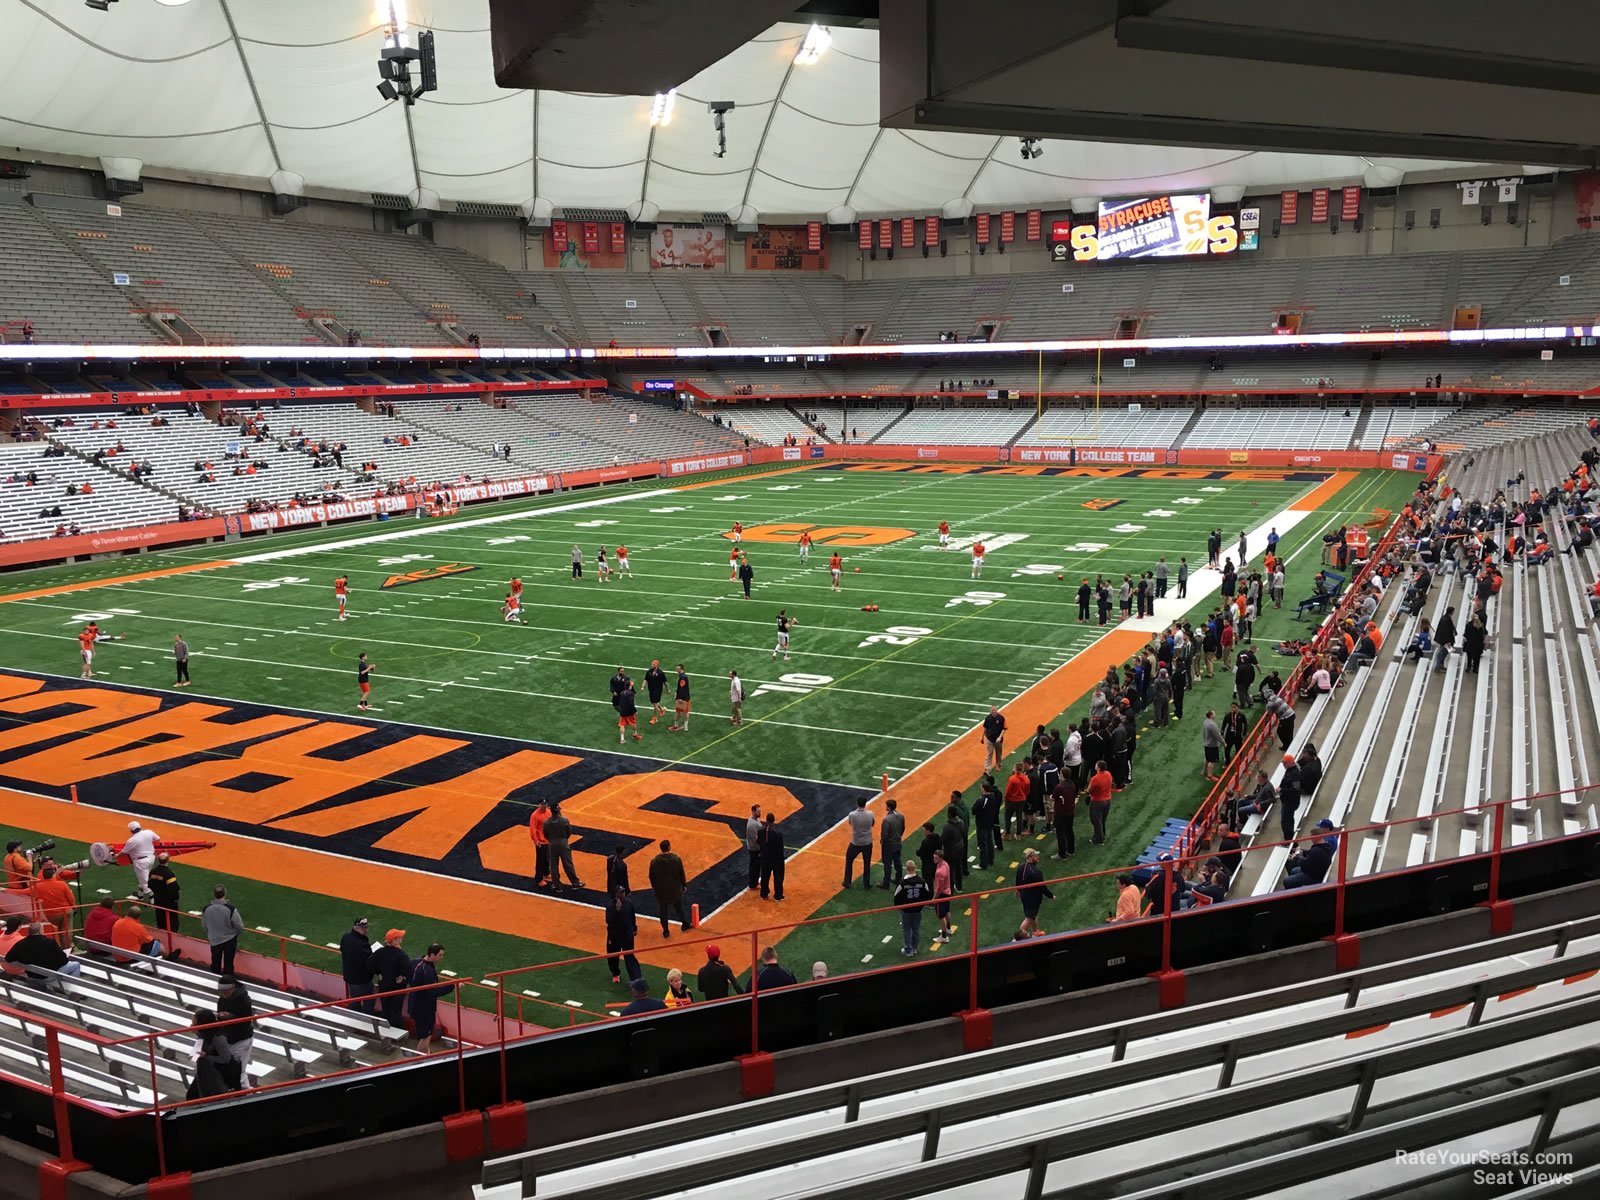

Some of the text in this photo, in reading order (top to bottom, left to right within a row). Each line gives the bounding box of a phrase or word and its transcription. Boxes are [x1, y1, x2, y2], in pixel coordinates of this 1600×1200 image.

[1099, 197, 1170, 231] SYRACUSE
[1071, 225, 1098, 261] S
[1208, 215, 1238, 254] S
[596, 348, 637, 357] SYRACUSE
[111, 393, 119, 404] S
[289, 388, 296, 397] S
[999, 448, 1010, 461] S
[1021, 450, 1155, 463] NEW YORKS COLLEGE TEAM
[1166, 451, 1178, 464] S
[671, 455, 744, 474] NEW YORK'S COLLEGE TEAM
[454, 487, 487, 502] YORK'S
[488, 482, 525, 498] COLLEGE
[525, 478, 548, 491] TEAM
[250, 495, 408, 529] NEW YORK'S COLLEGE TEAM
[227, 516, 239, 534] S
[383, 562, 477, 588] ACC
[949, 590, 1008, 605] 30
[866, 625, 934, 646] 20
[756, 672, 835, 695] 10
